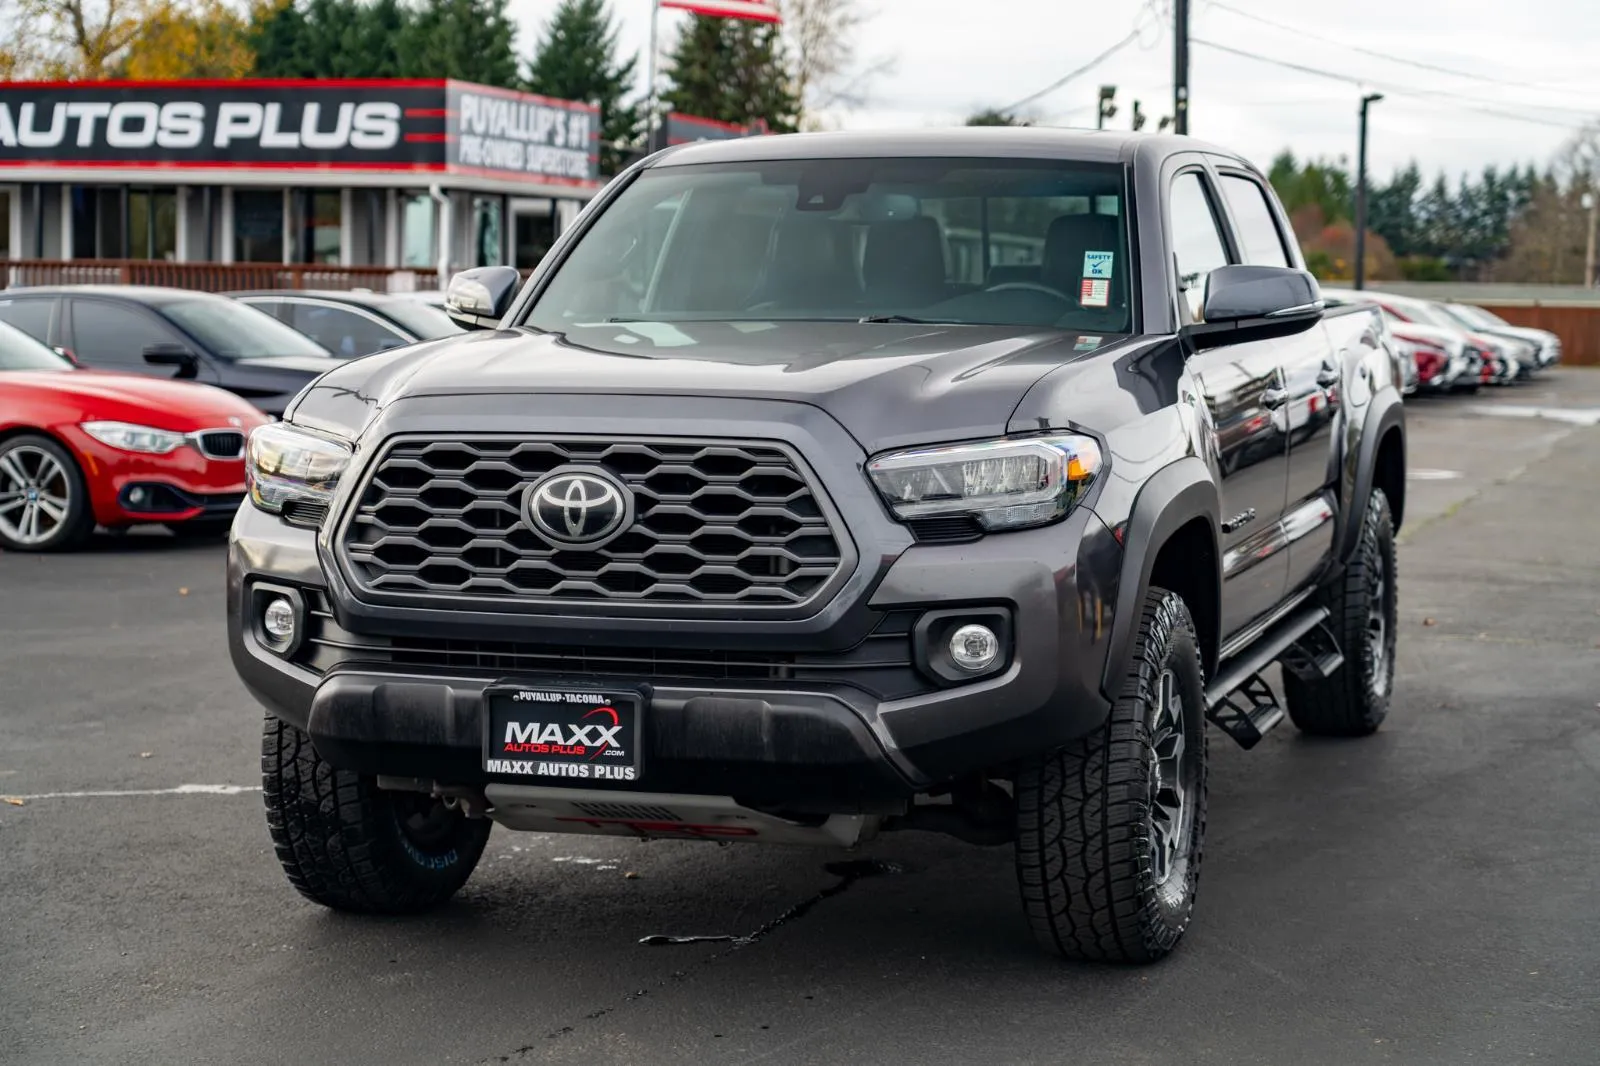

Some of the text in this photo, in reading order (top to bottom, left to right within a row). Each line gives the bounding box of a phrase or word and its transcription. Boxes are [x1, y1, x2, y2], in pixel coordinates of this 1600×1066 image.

[213, 101, 401, 149] PLUS
[568, 113, 590, 149] #1
[504, 721, 623, 748] MAXX
[503, 742, 586, 755] AUTOS PLUS
[486, 759, 635, 780] MAXX AUTOS PLUS
